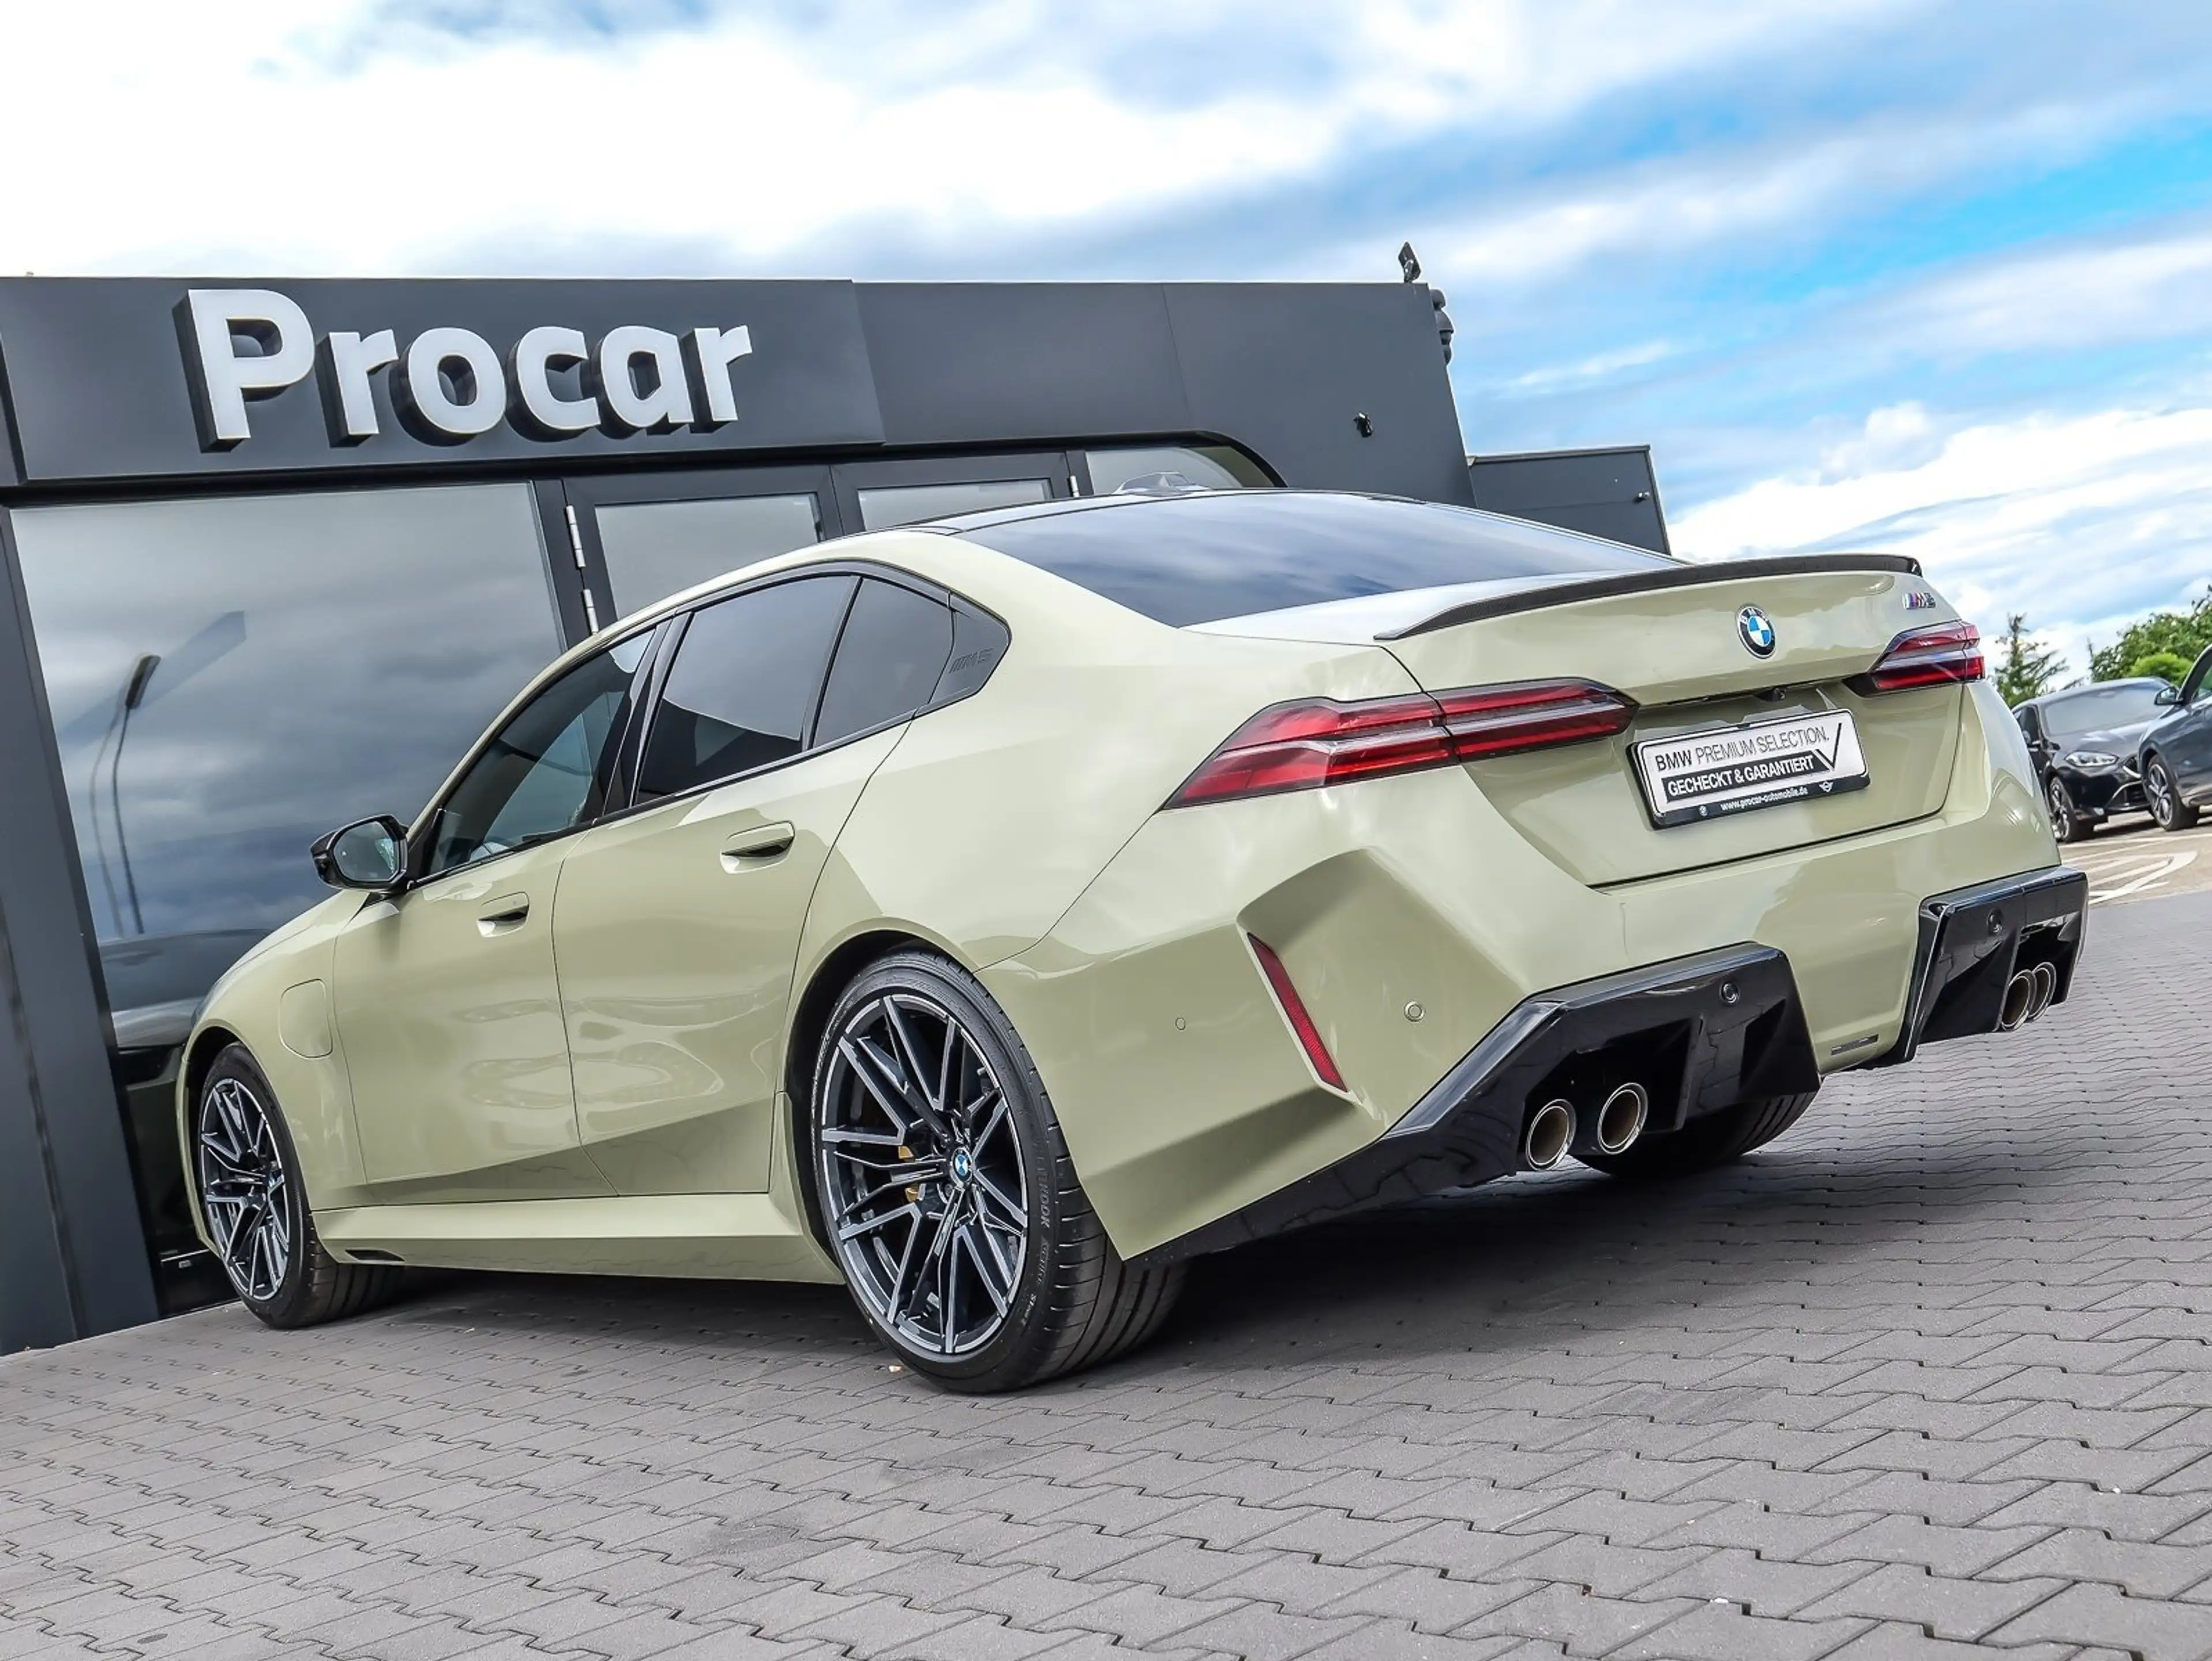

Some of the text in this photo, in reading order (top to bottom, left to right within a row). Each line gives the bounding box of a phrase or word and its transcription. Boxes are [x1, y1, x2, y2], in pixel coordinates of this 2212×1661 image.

[187, 288, 753, 439] Procar
[1655, 726, 1830, 772] BMW PREMIUM SELECTION.
[1668, 754, 1815, 796] GECHECKT & GARANTIERT
[1721, 786, 1809, 811] www.procar-automobile.de
